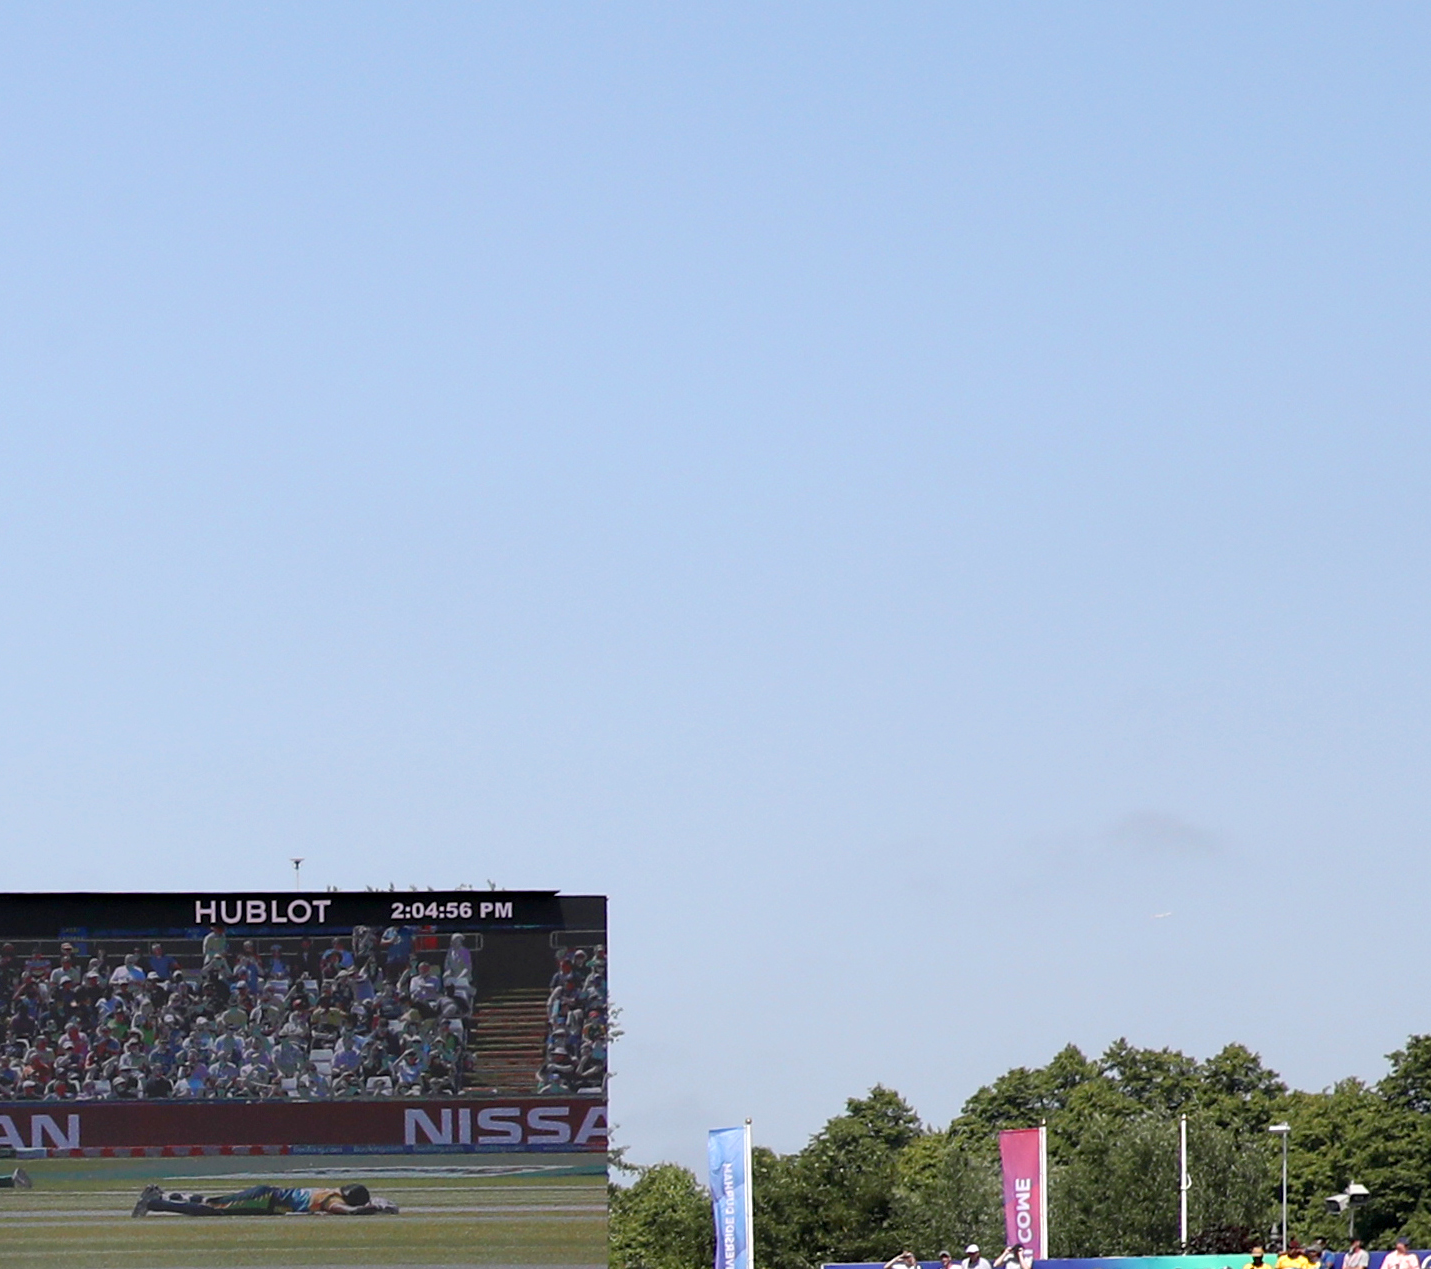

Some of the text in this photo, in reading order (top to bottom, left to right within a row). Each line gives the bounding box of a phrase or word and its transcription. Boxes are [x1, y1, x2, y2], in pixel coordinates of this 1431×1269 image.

[194, 899, 332, 924] HUBLOT
[390, 901, 514, 920] 2:04:56 PM
